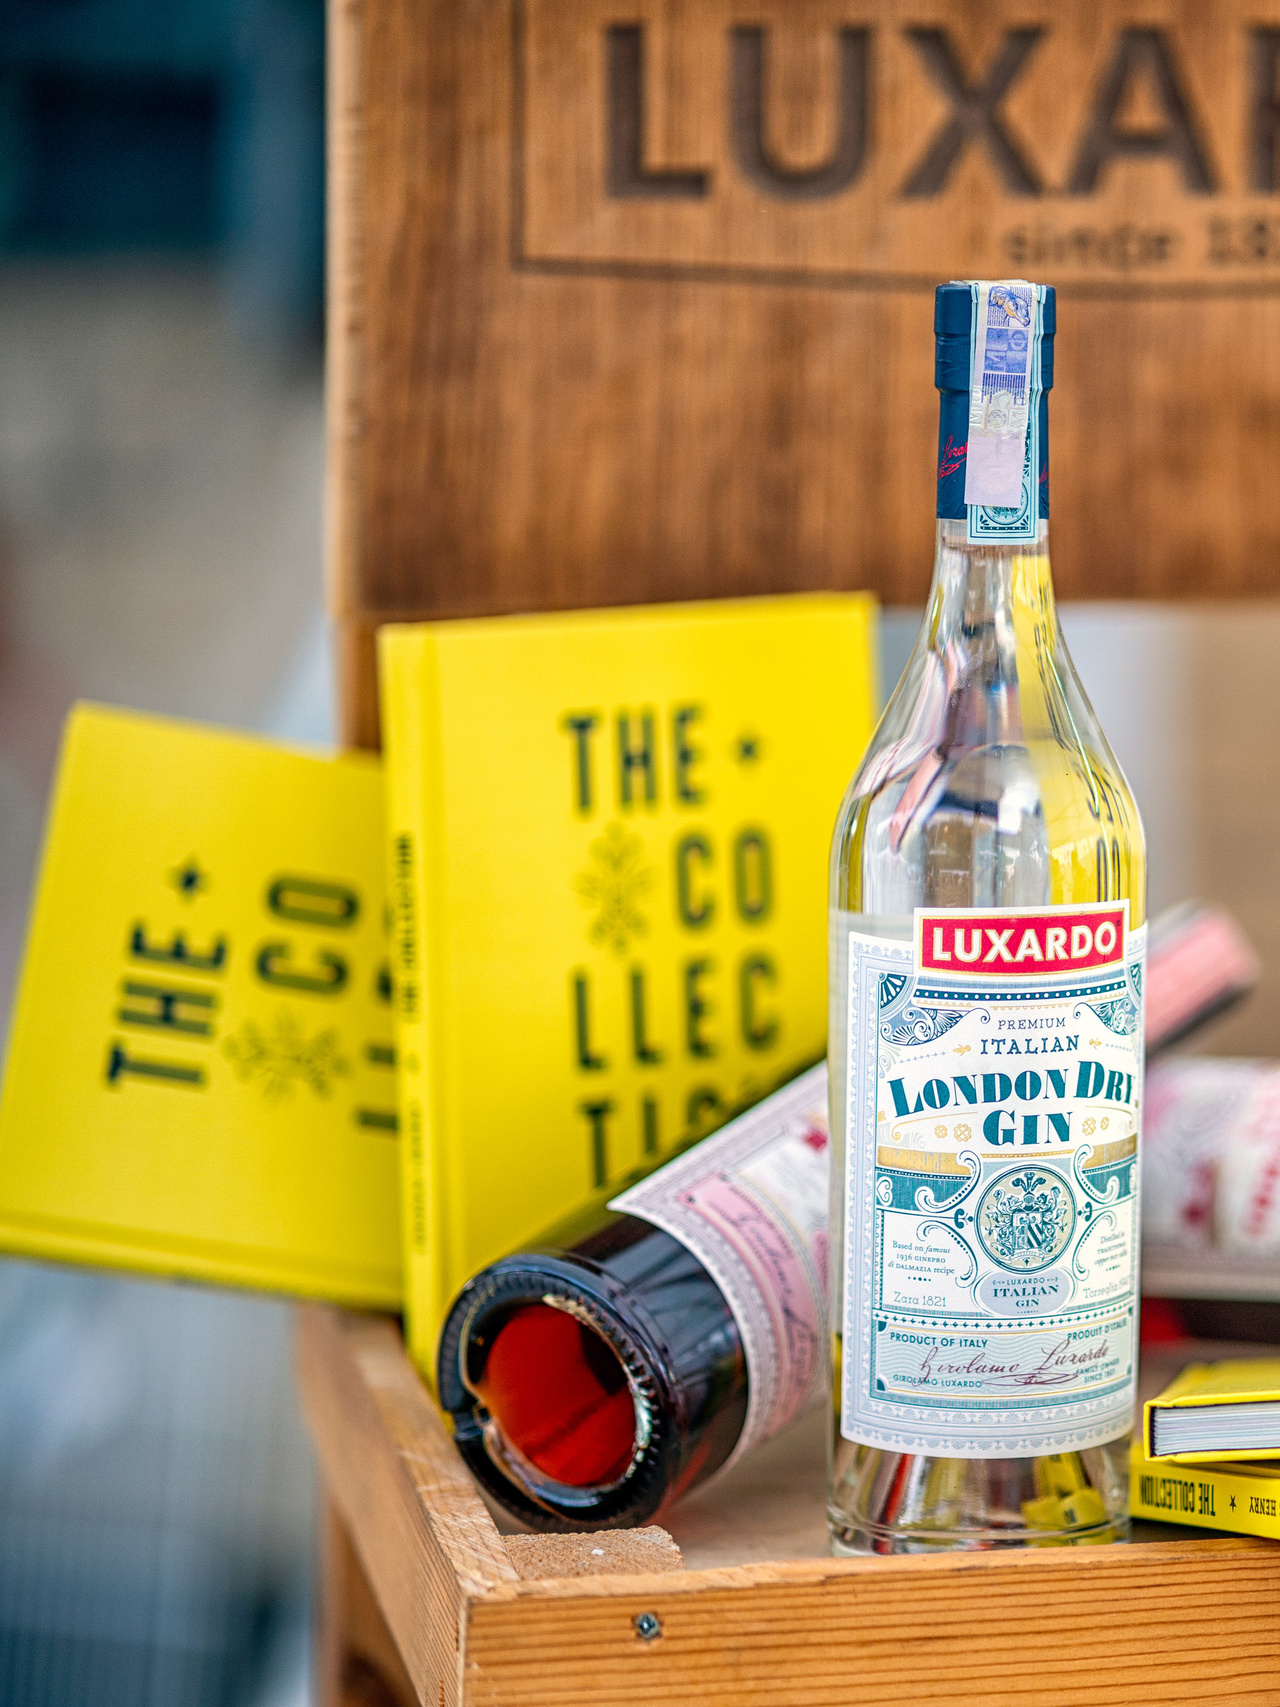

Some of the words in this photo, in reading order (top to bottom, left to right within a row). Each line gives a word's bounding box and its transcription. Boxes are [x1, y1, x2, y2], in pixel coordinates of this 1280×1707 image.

[562, 702, 712, 814] THE
[676, 826, 776, 930] CO
[255, 869, 361, 997] CO
[932, 920, 1117, 963] LUXARDO
[105, 918, 230, 1091] THE
[570, 950, 781, 1072] LLEC
[998, 1017, 1066, 1031] PREMIUM
[980, 1034, 1080, 1055] ITALIAN
[887, 1068, 1070, 1118] LONDON
[982, 1109, 1073, 1147] GIN
[892, 1240, 913, 1251] Based
[924, 1244, 951, 1254] famous
[896, 1253, 913, 1262] 1936
[914, 1255, 946, 1264] GINEPRO
[895, 1263, 932, 1273] DALMAZIA
[933, 1266, 955, 1276] recipe
[1006, 1277, 1045, 1286] LUXARDO
[893, 1291, 919, 1305] Zara
[922, 1295, 947, 1307] 1821
[993, 1284, 1059, 1298] ITALIAN
[1015, 1298, 1040, 1308] GIN
[890, 1332, 937, 1346] PRODUCT
[940, 1337, 955, 1347] OF
[959, 1338, 988, 1348] ITALY
[1067, 1326, 1103, 1341] PRODUIT
[892, 1374, 938, 1386] GIROLAMO
[941, 1379, 983, 1388] LUXARDO
[1084, 1372, 1103, 1384] SINCE
[1139, 1474, 1195, 1514] COLLECTION
[1198, 1483, 1216, 1517] THE
[1249, 1496, 1277, 1517] HENRY
